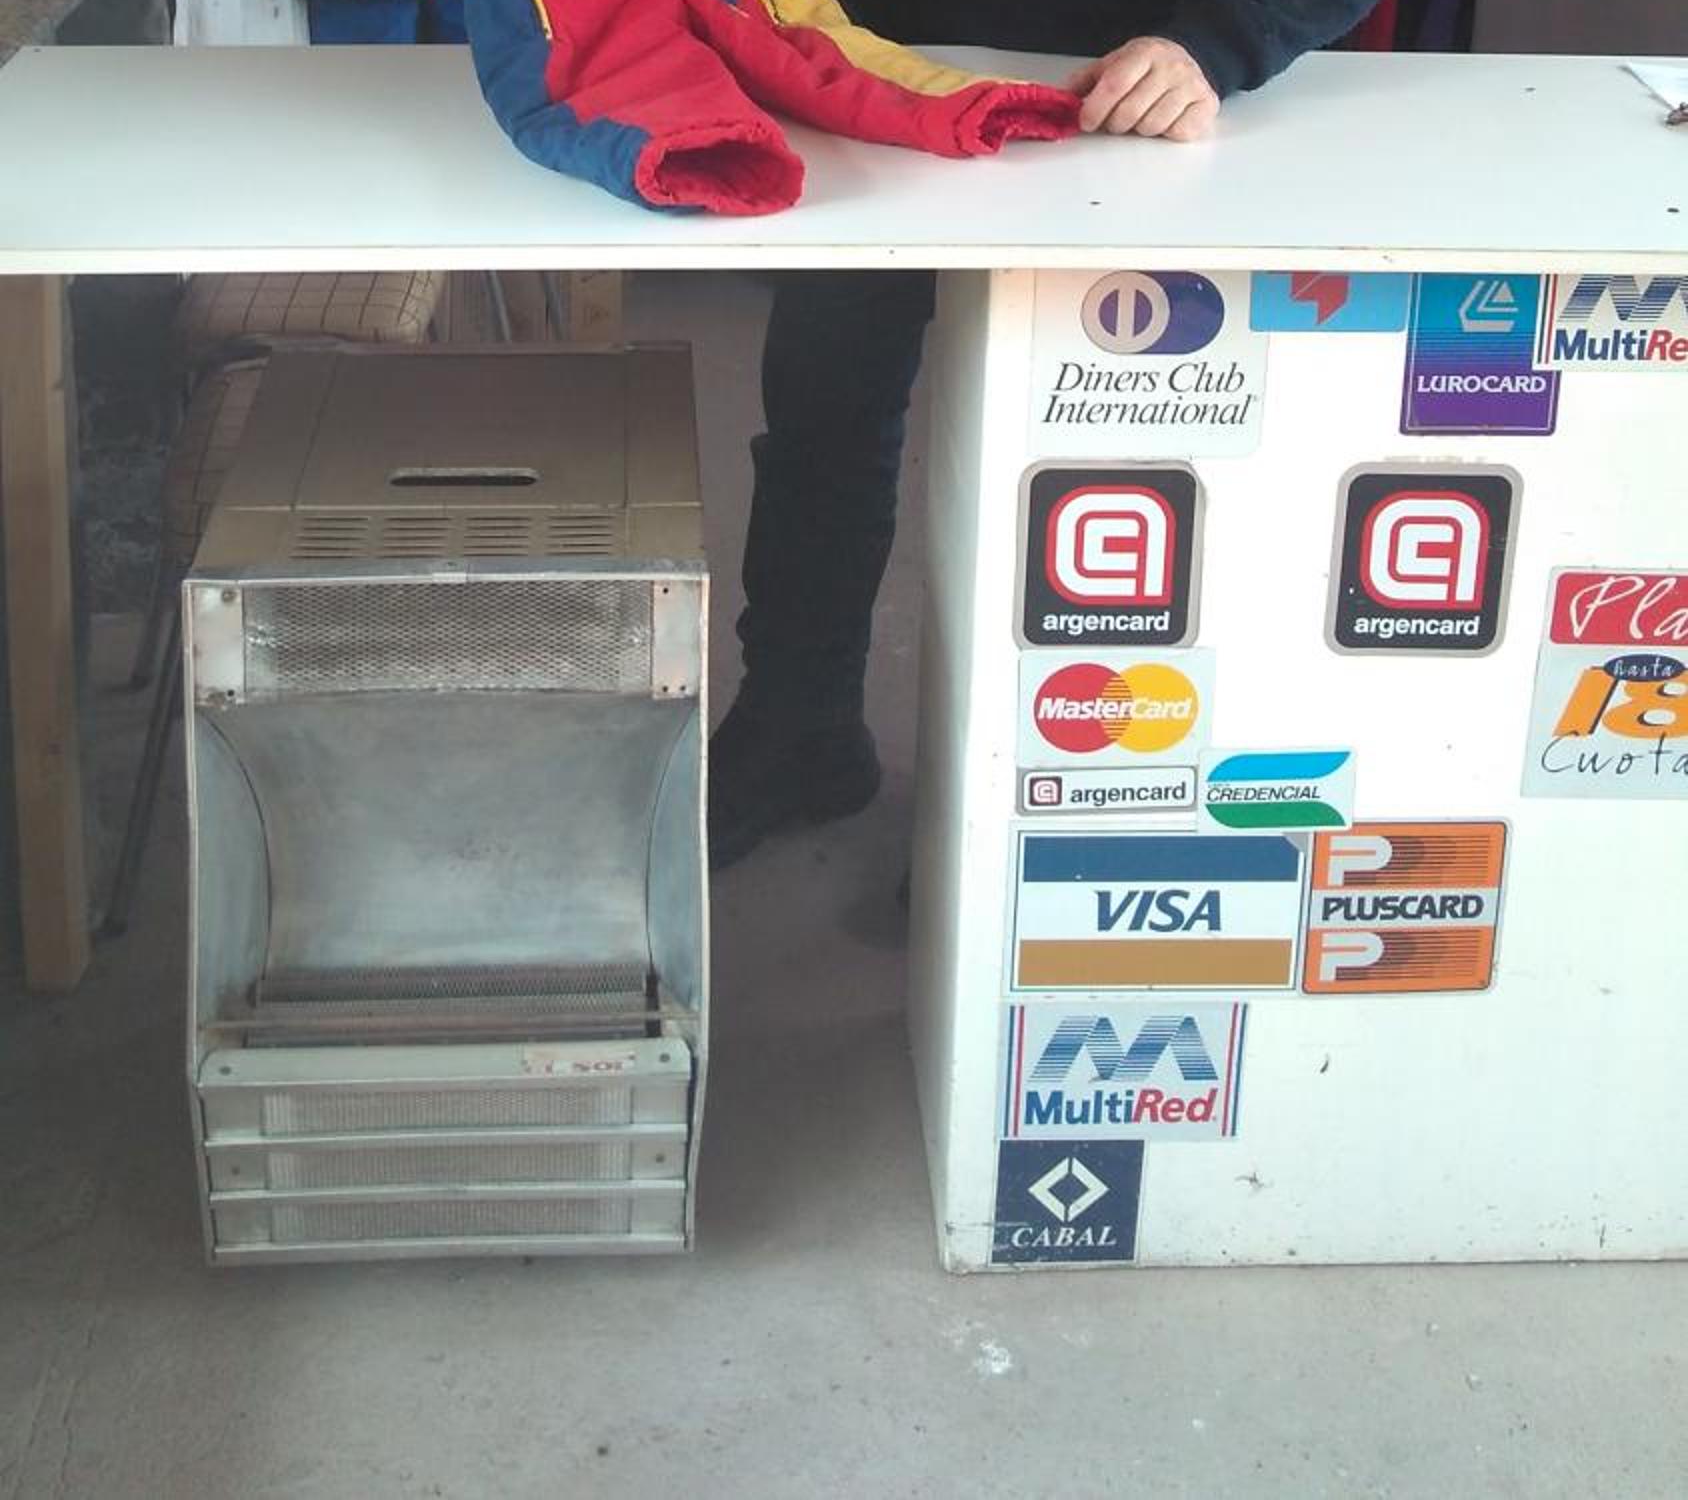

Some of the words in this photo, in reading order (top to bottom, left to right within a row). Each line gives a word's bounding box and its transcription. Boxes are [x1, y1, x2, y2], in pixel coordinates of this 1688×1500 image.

[1053, 361, 1161, 393] Diners
[1167, 361, 1246, 393] Club
[1042, 394, 1253, 425] International
[1042, 611, 1170, 636] argencard
[1353, 615, 1480, 639] argencard
[1613, 657, 1675, 678] hasta
[1037, 697, 1190, 721] MasterCard
[1552, 667, 1688, 739] 18
[1069, 782, 1187, 807] argencard
[1207, 785, 1321, 802] CREDENCIAL
[1094, 889, 1222, 932] VISA
[1321, 894, 1484, 921] PLUSCARD
[1023, 1088, 1219, 1125] MultiRed
[1011, 1226, 1117, 1247] CABAL
